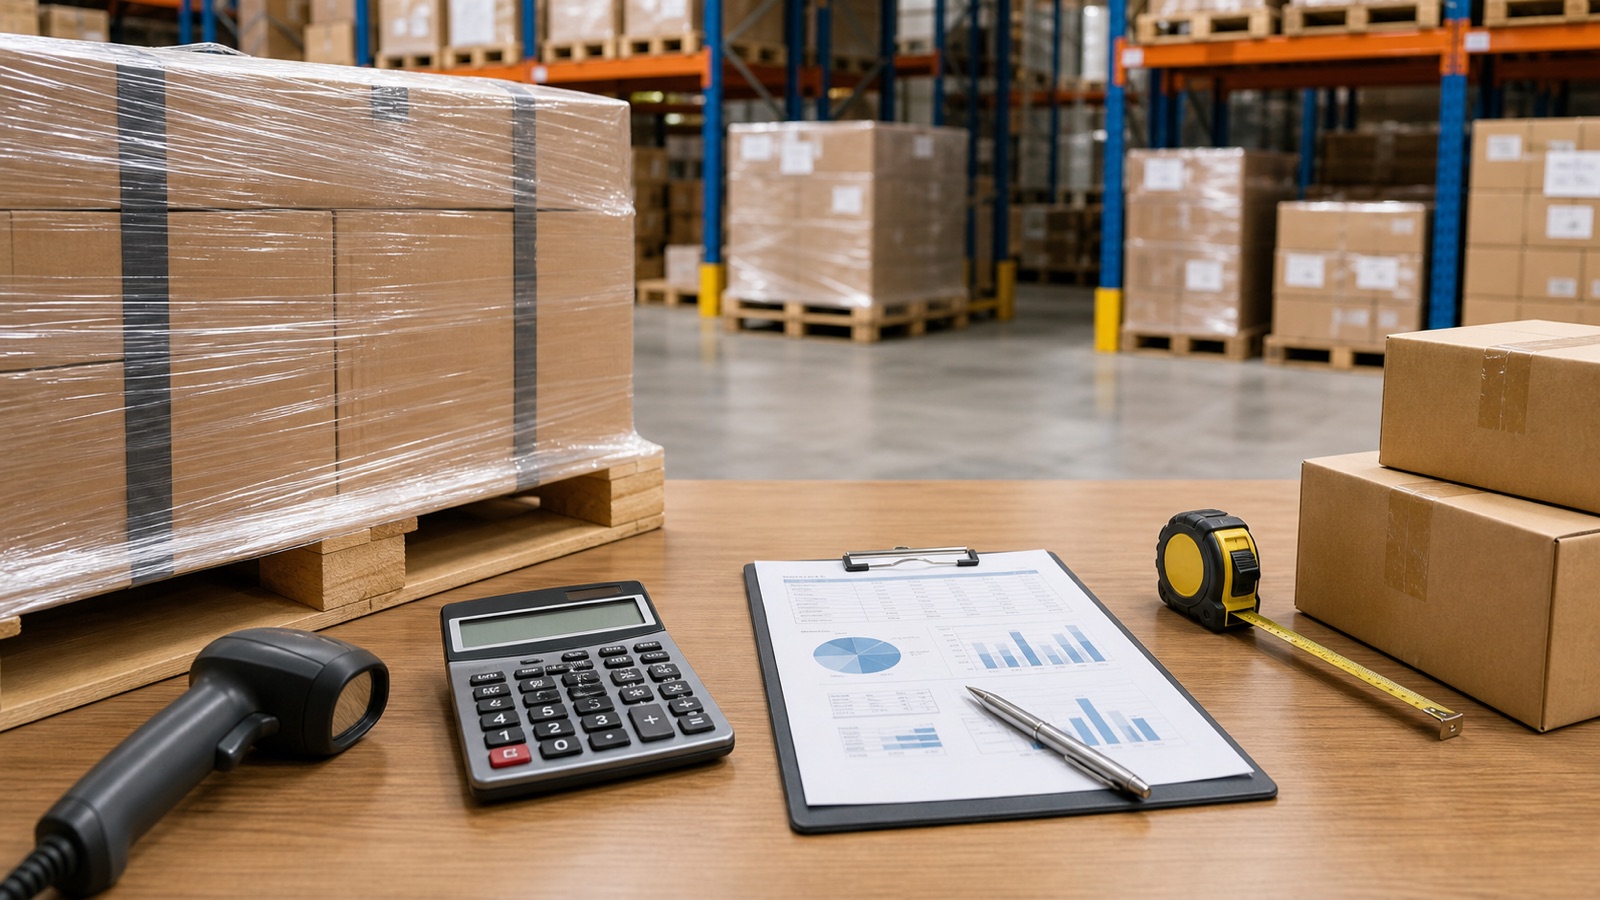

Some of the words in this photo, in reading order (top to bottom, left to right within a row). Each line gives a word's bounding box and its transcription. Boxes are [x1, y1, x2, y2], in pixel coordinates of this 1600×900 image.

[542, 706, 554, 716] 5
[493, 713, 506, 724] 4
[595, 715, 608, 725] 3
[548, 722, 561, 734] 2
[499, 730, 510, 741] 1
[554, 739, 568, 751] 0
